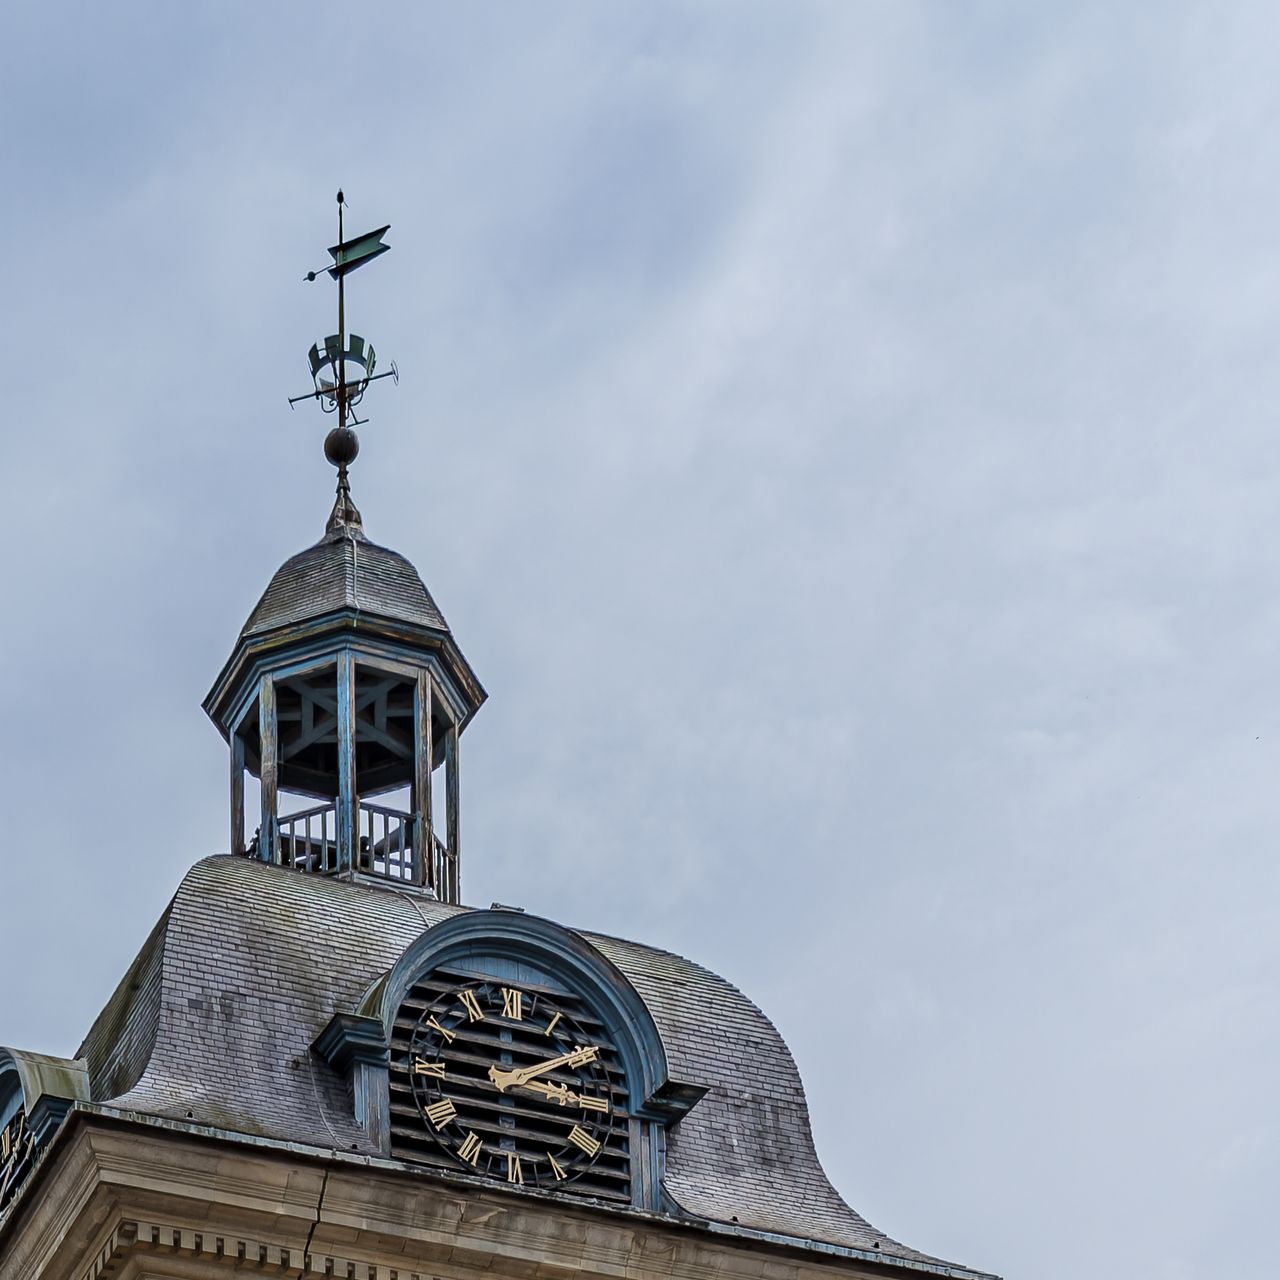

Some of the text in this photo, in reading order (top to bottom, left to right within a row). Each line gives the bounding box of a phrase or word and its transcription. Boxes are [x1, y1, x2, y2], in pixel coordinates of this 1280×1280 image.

[457, 989, 485, 1023] XI
[501, 987, 523, 1021] XII
[426, 1015, 457, 1044] X
[415, 1056, 447, 1080] IX
[424, 1098, 458, 1131] VIII
[579, 1093, 609, 1113] III
[456, 1130, 483, 1167] VII
[507, 1151, 525, 1185] VI
[547, 1151, 567, 1181] V
